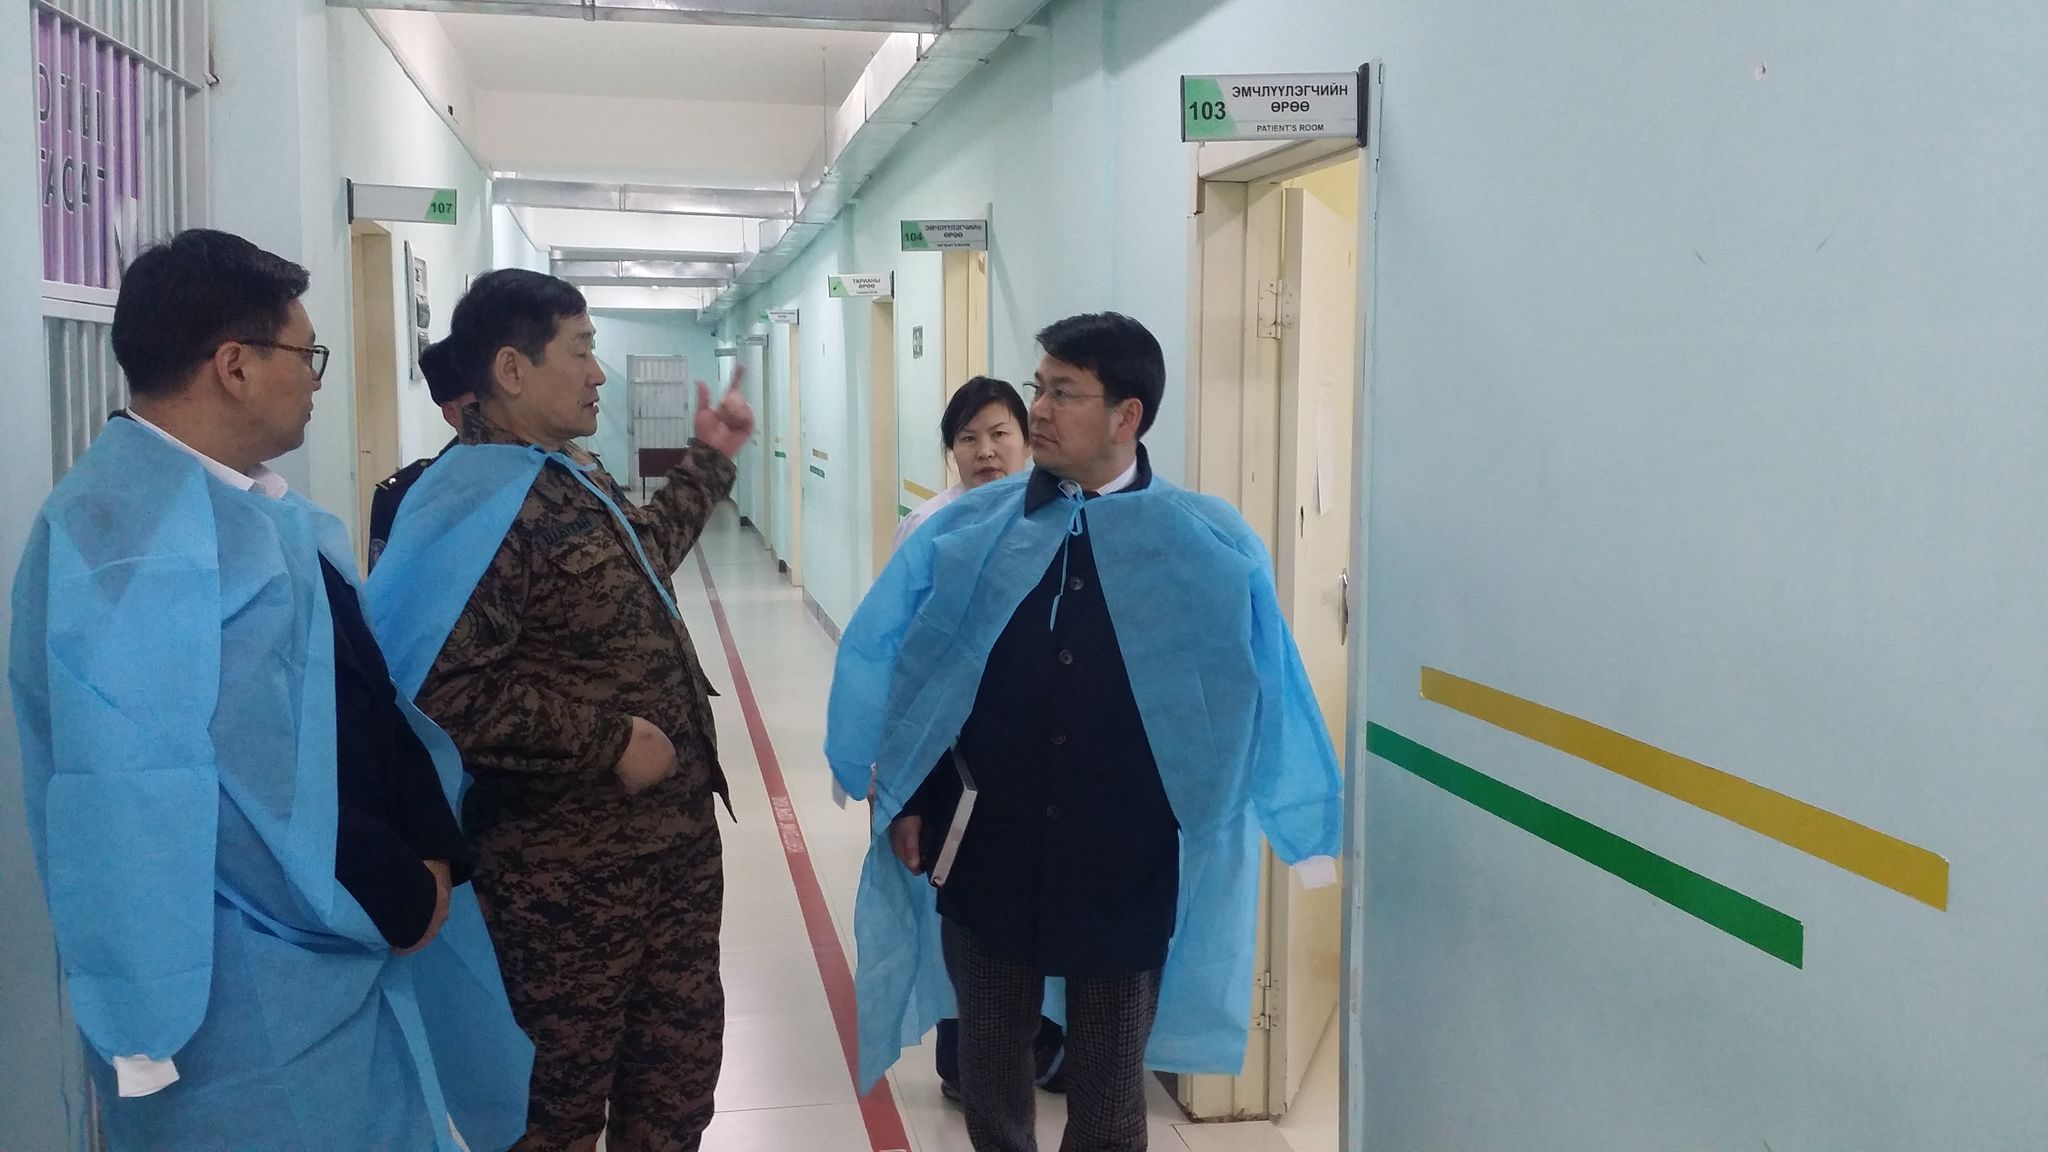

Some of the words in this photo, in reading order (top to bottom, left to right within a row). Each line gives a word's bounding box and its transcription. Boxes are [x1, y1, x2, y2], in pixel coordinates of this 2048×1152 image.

[1232, 83, 1349, 98] ЭМЧЛҮҮЛЭГЧИЙН
[1189, 101, 1227, 121] 103
[1271, 101, 1310, 113] ӨРӨӨ
[1256, 124, 1298, 133] PATIENT'S
[1299, 123, 1324, 132] ROOM
[430, 202, 453, 214] 107
[905, 232, 923, 242] 104
